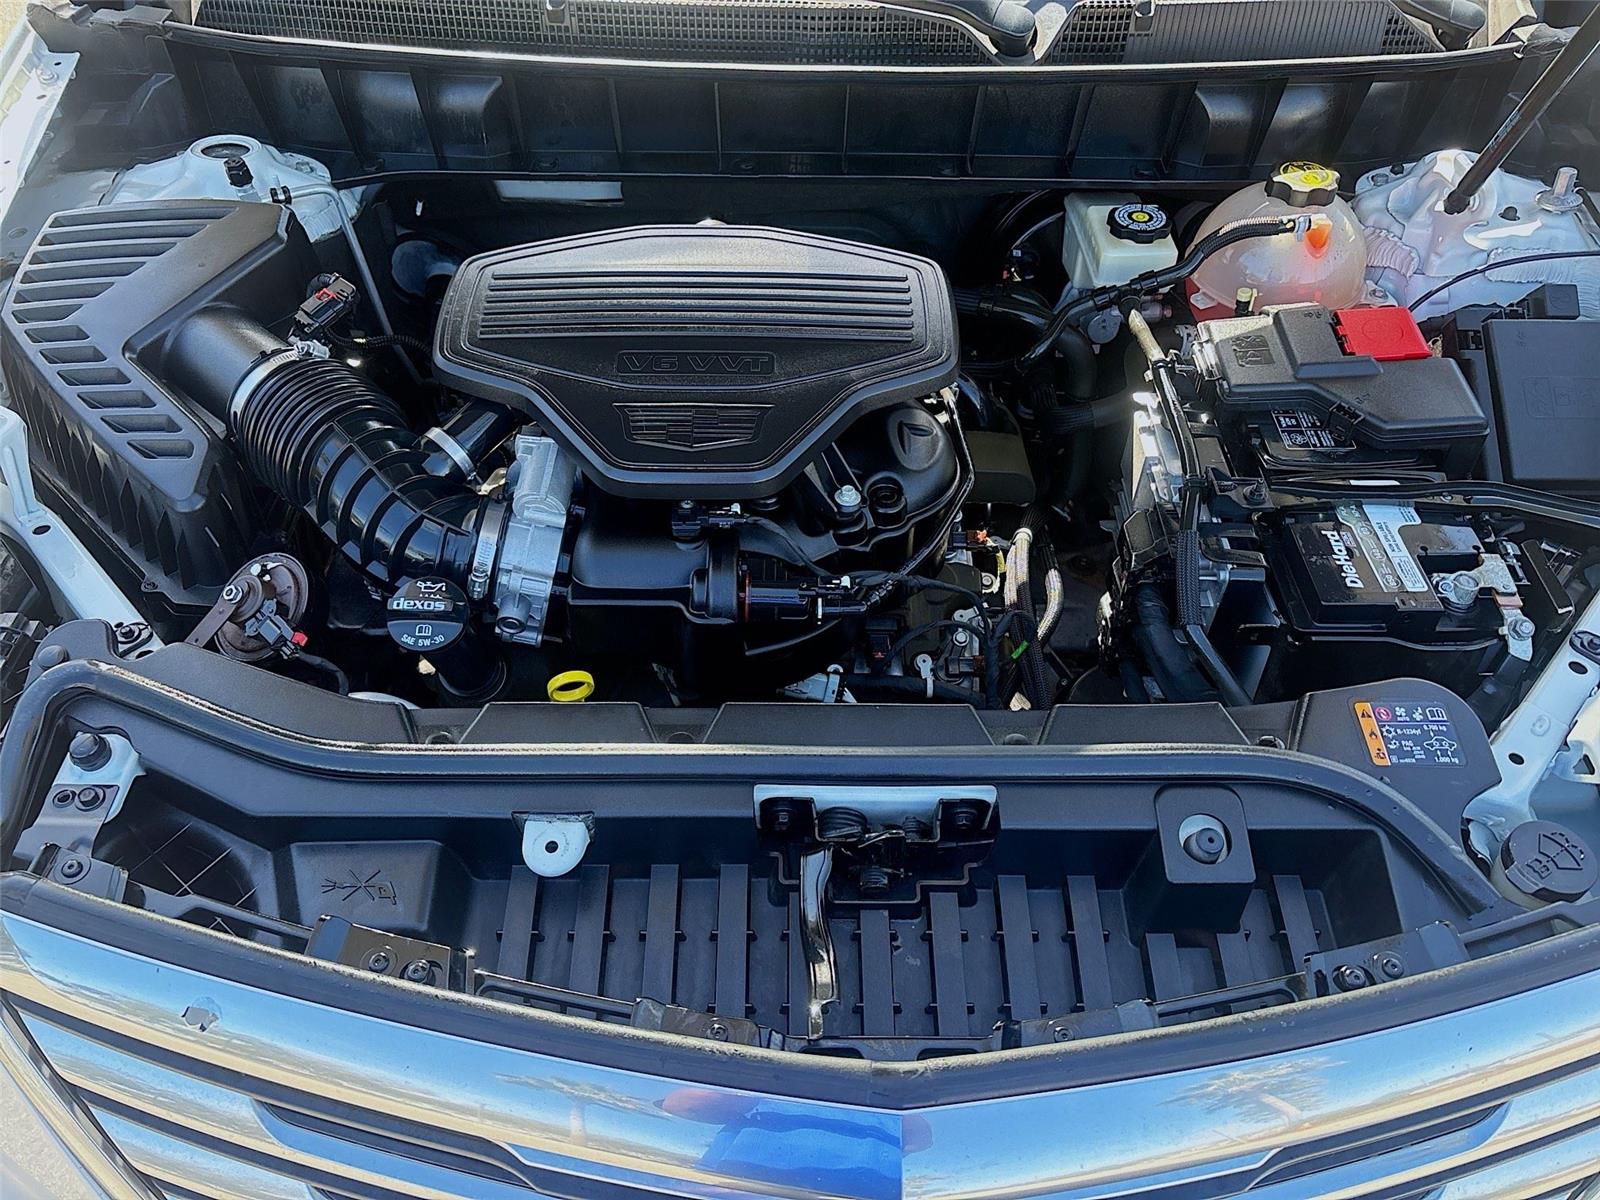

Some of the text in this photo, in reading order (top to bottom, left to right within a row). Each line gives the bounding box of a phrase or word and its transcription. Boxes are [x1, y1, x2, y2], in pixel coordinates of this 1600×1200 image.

[623, 355, 769, 372] V6 VVT
[1321, 530, 1364, 588] DieHard
[392, 597, 446, 610] dexos
[401, 634, 445, 646] SAE 5W-30
